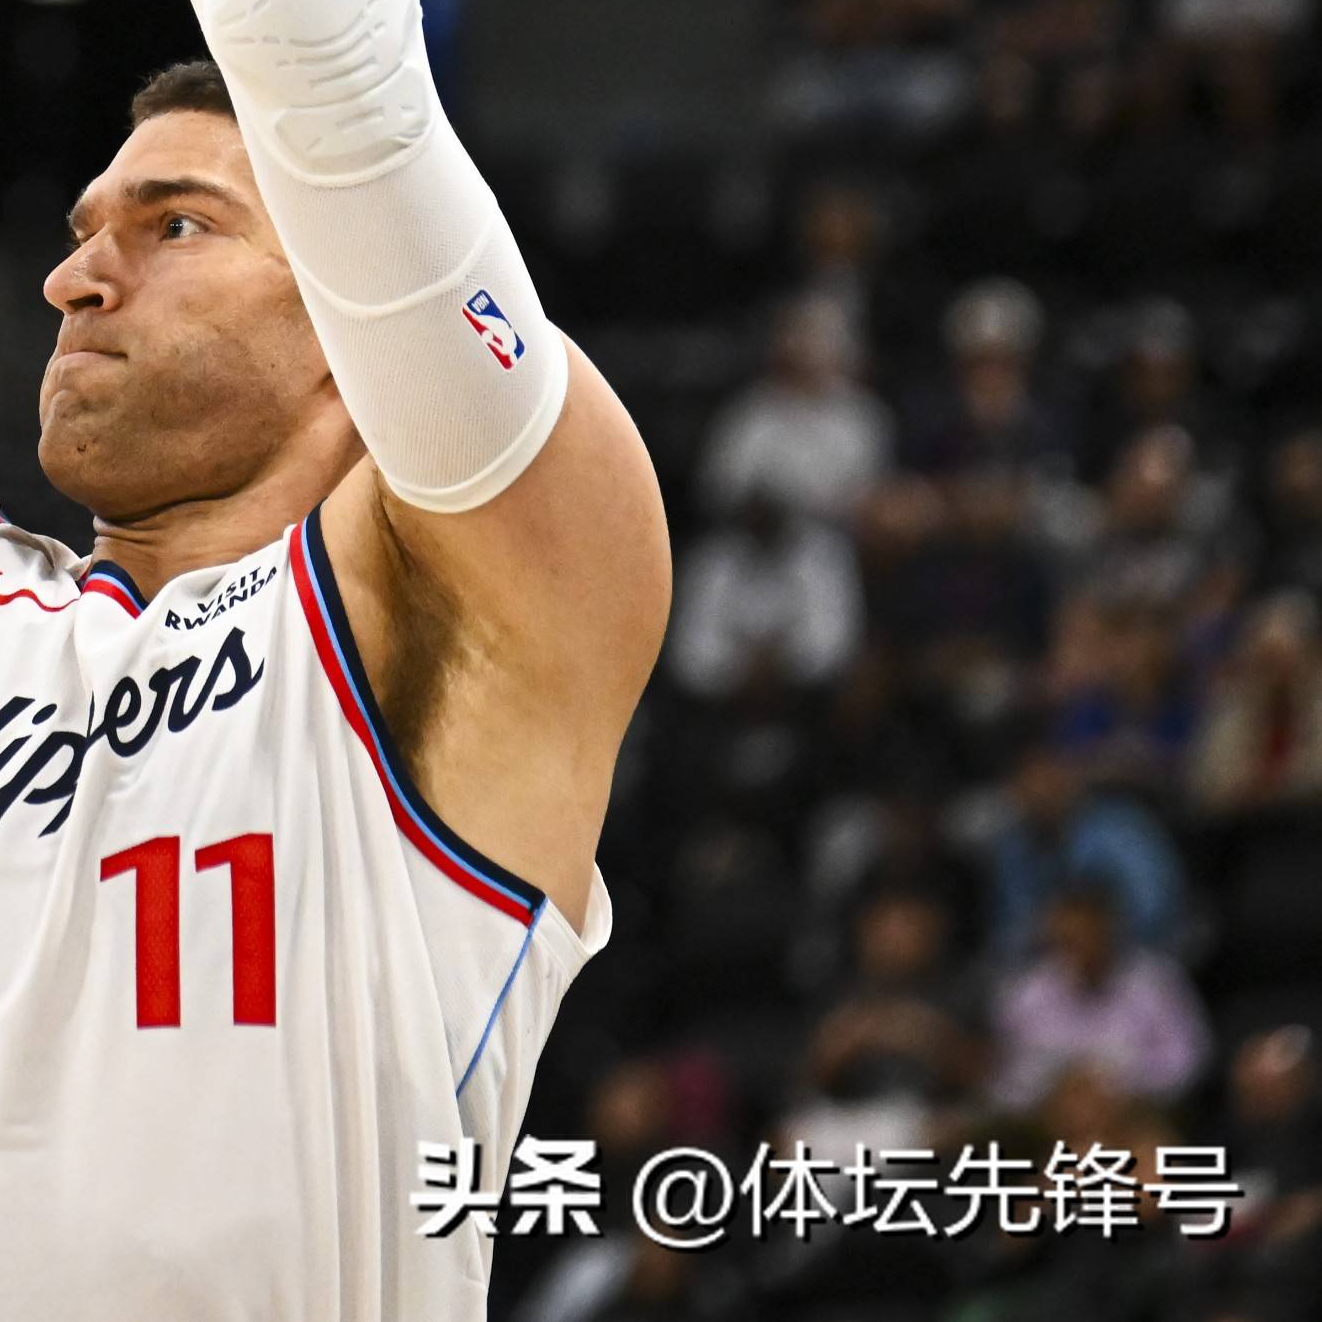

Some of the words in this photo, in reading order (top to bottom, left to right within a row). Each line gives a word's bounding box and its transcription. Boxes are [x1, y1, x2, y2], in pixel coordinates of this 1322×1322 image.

[471, 293, 490, 314] NBA
[164, 566, 277, 631] RWANDA
[197, 566, 262, 614] VISIT
[100, 832, 277, 1029] 11
